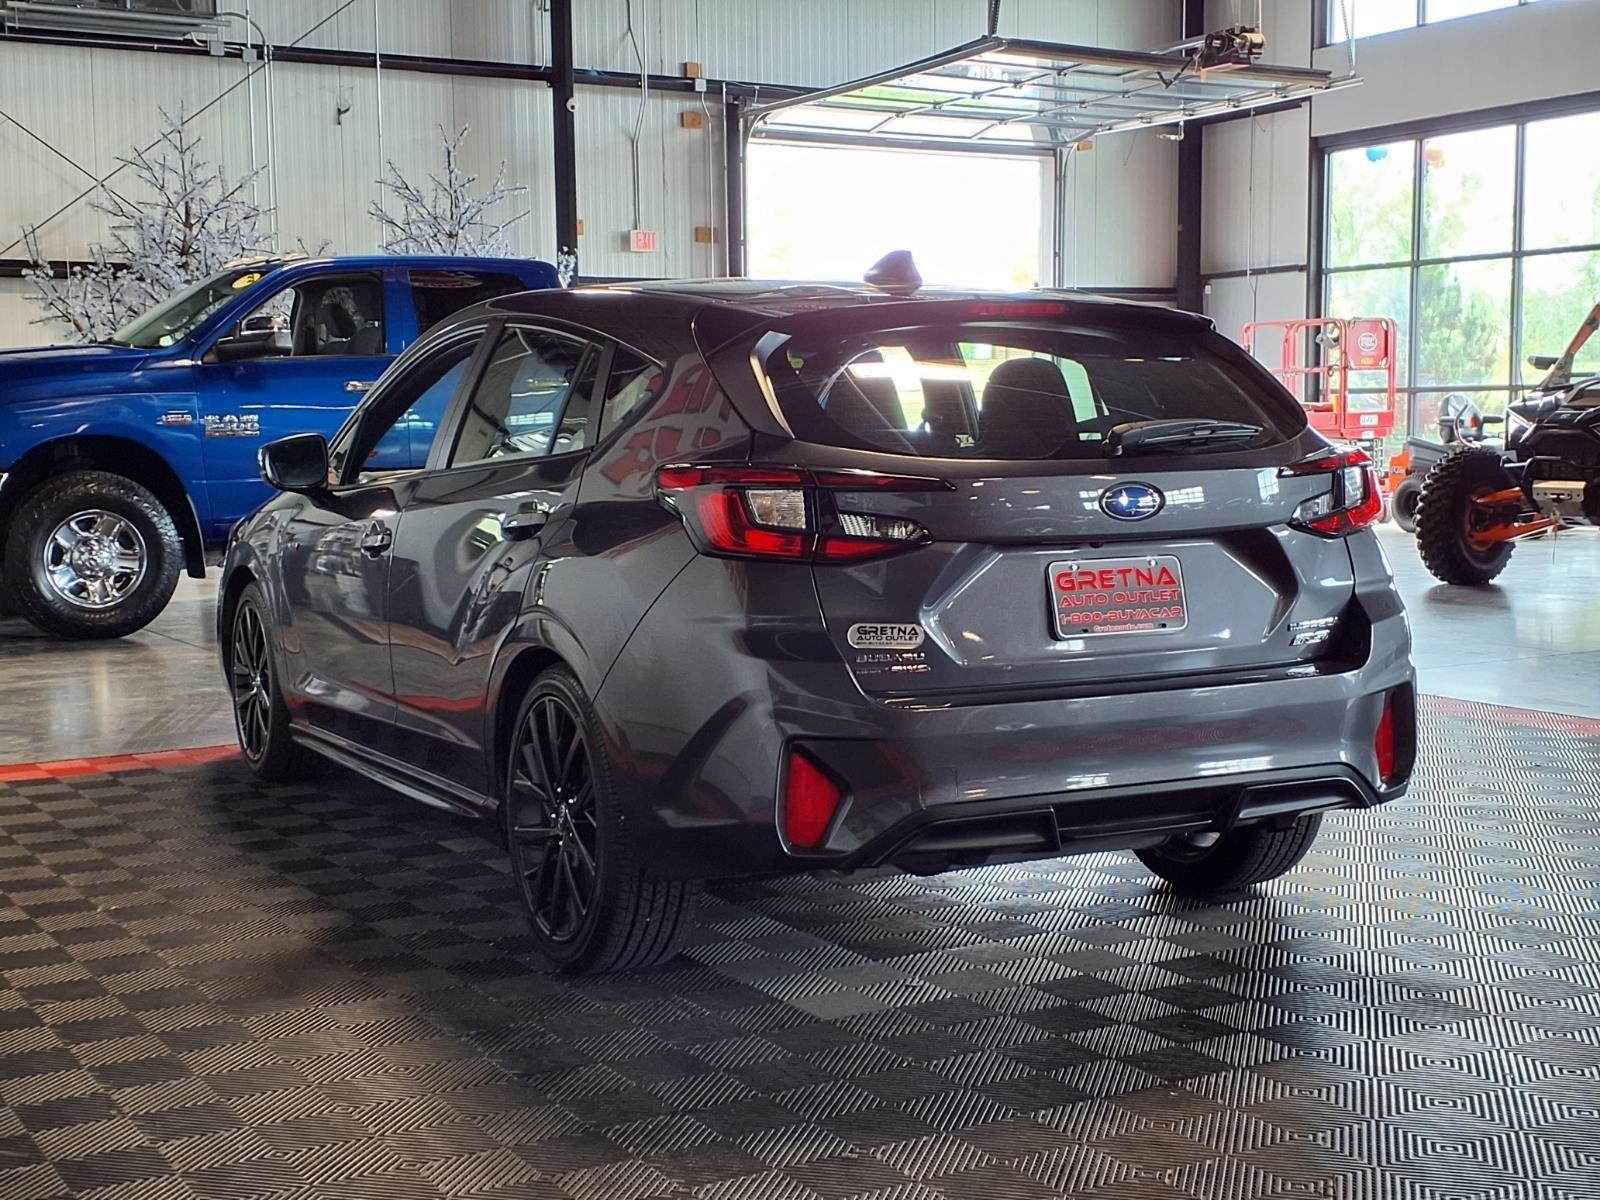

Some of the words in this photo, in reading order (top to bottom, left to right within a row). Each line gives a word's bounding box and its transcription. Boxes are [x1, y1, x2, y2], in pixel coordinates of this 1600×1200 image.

[636, 231, 656, 249] EXIT
[1055, 566, 1179, 592] GRETNA
[1059, 592, 1109, 608] AUTO
[1112, 588, 1180, 605] OUTLET
[1060, 605, 1183, 625] 1-800-BUYACAR
[856, 626, 919, 635] GRETNA
